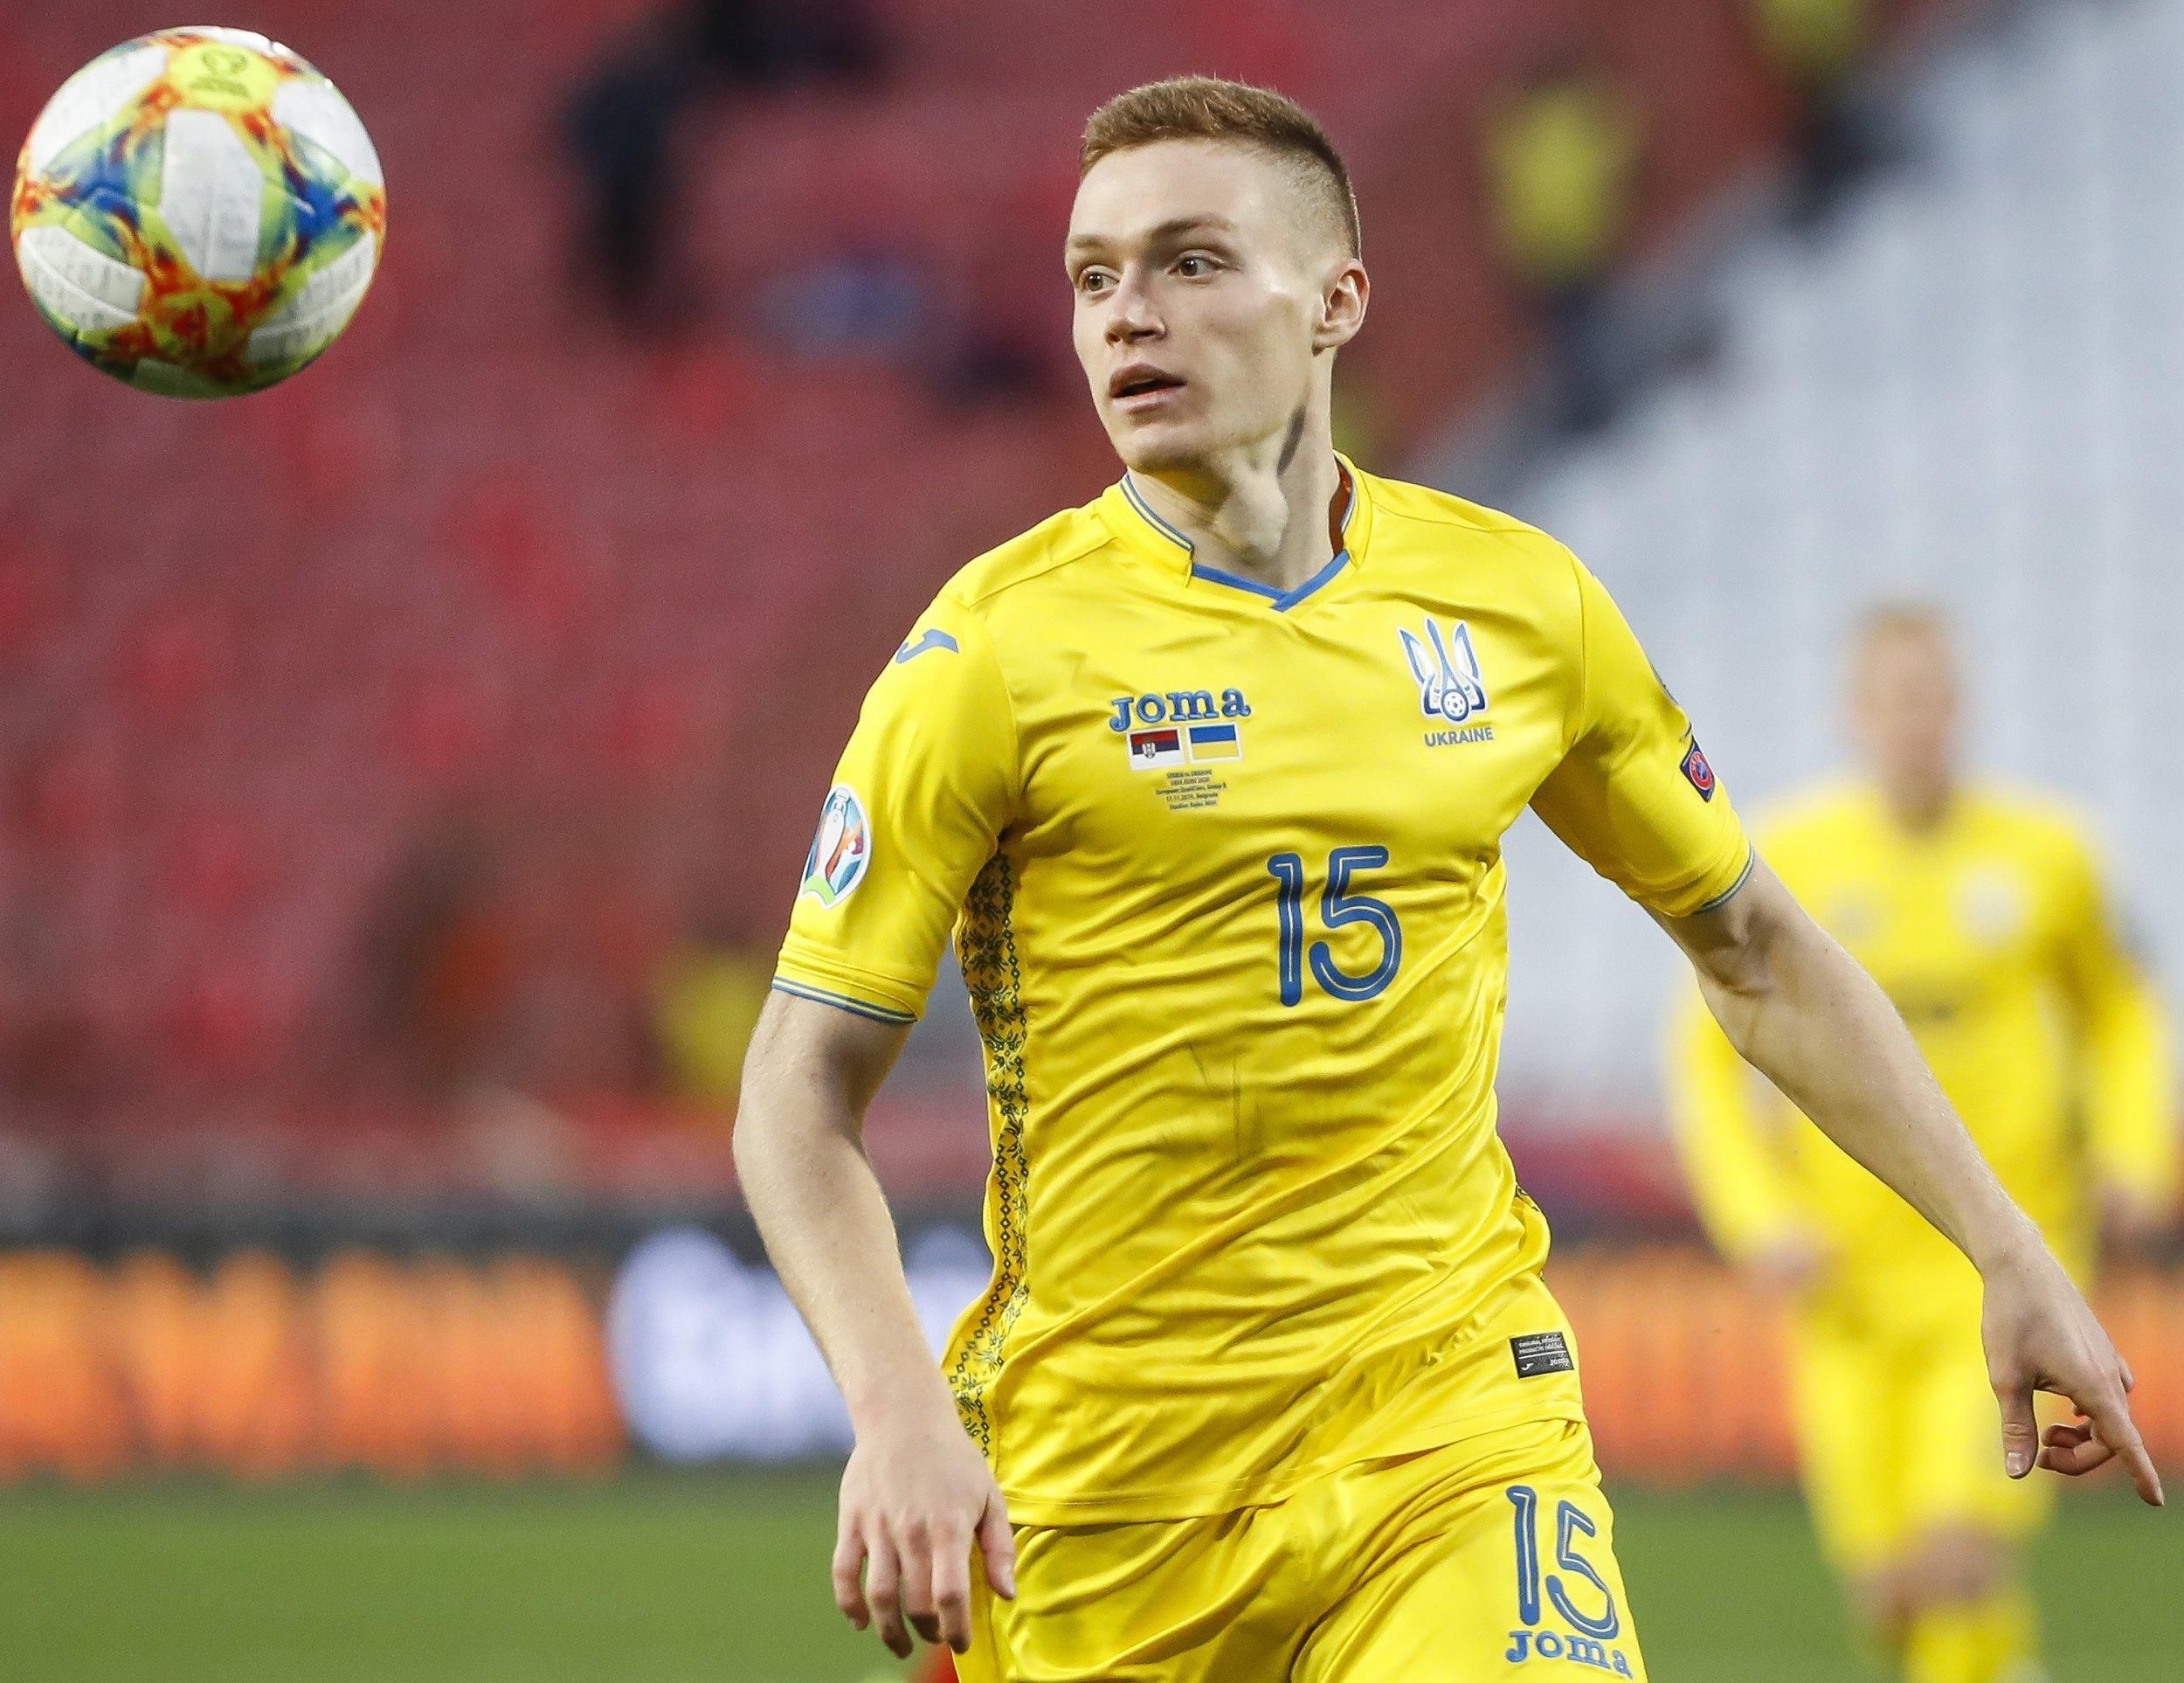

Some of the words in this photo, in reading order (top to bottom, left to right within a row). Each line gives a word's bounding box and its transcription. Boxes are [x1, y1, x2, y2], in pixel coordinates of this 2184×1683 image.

[1424, 727, 1494, 747] UKRAINE
[1267, 845, 1402, 1007] 15
[1506, 1486, 1619, 1640] 15
